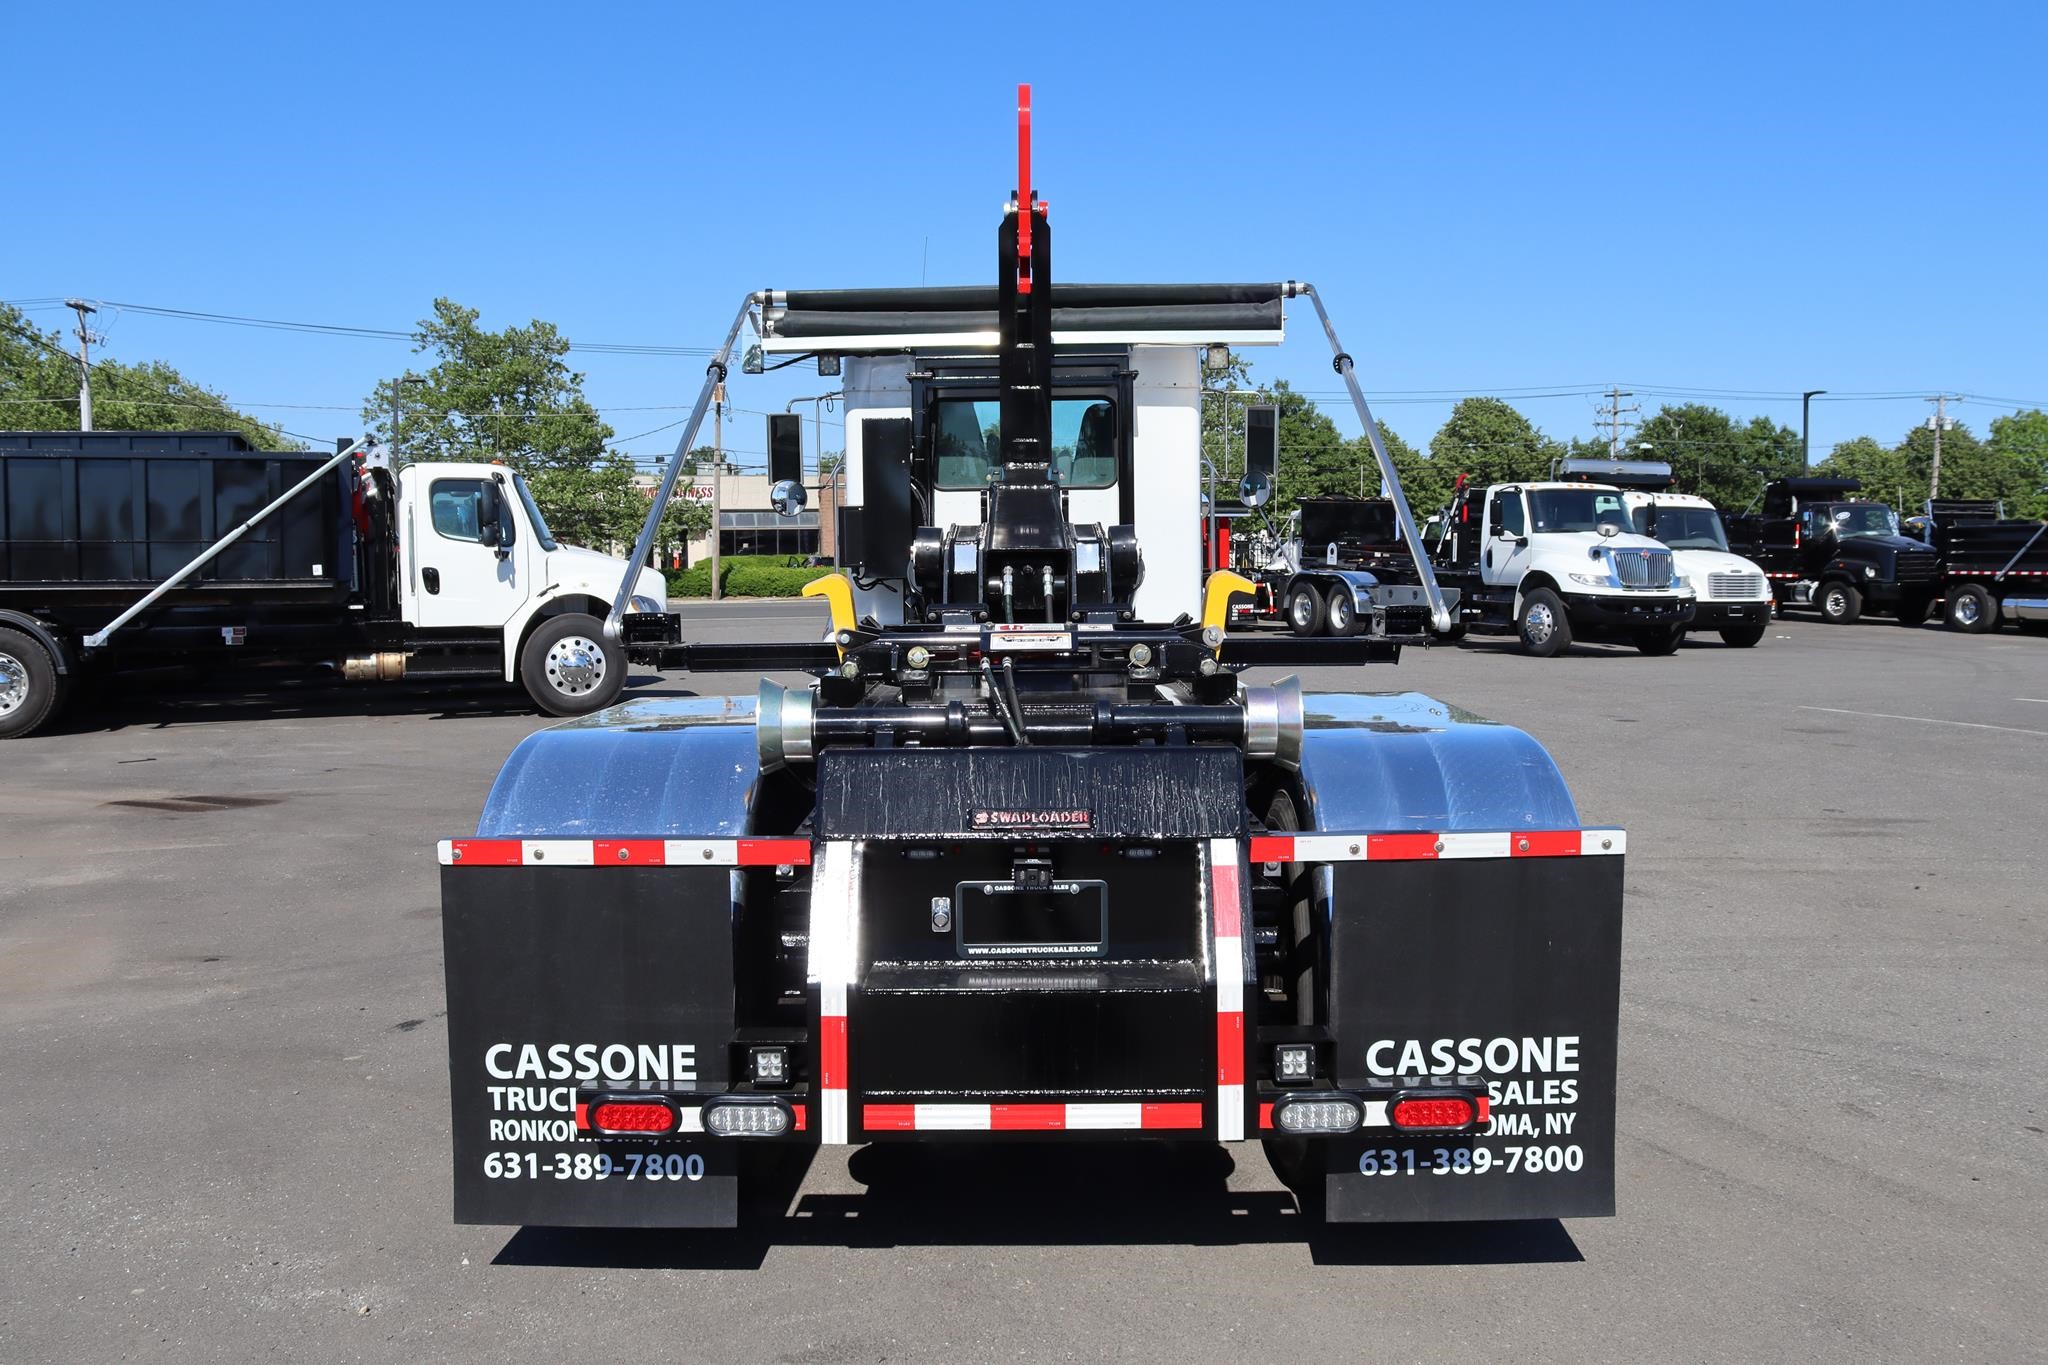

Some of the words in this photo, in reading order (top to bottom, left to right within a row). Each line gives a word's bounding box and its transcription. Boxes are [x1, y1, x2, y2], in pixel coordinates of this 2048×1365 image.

[990, 811, 1089, 823] SWAPLOADER
[967, 946, 1098, 955] WWW.CASSONETRUCKSALES.COM
[484, 1043, 697, 1080] CASSONE
[1365, 1035, 1580, 1076] CASSONE
[1488, 1079, 1579, 1106] SALES
[1545, 1112, 1577, 1135] NY
[483, 1151, 705, 1181] 631-389-7800
[1359, 1145, 1584, 1177] 631-389-7800
